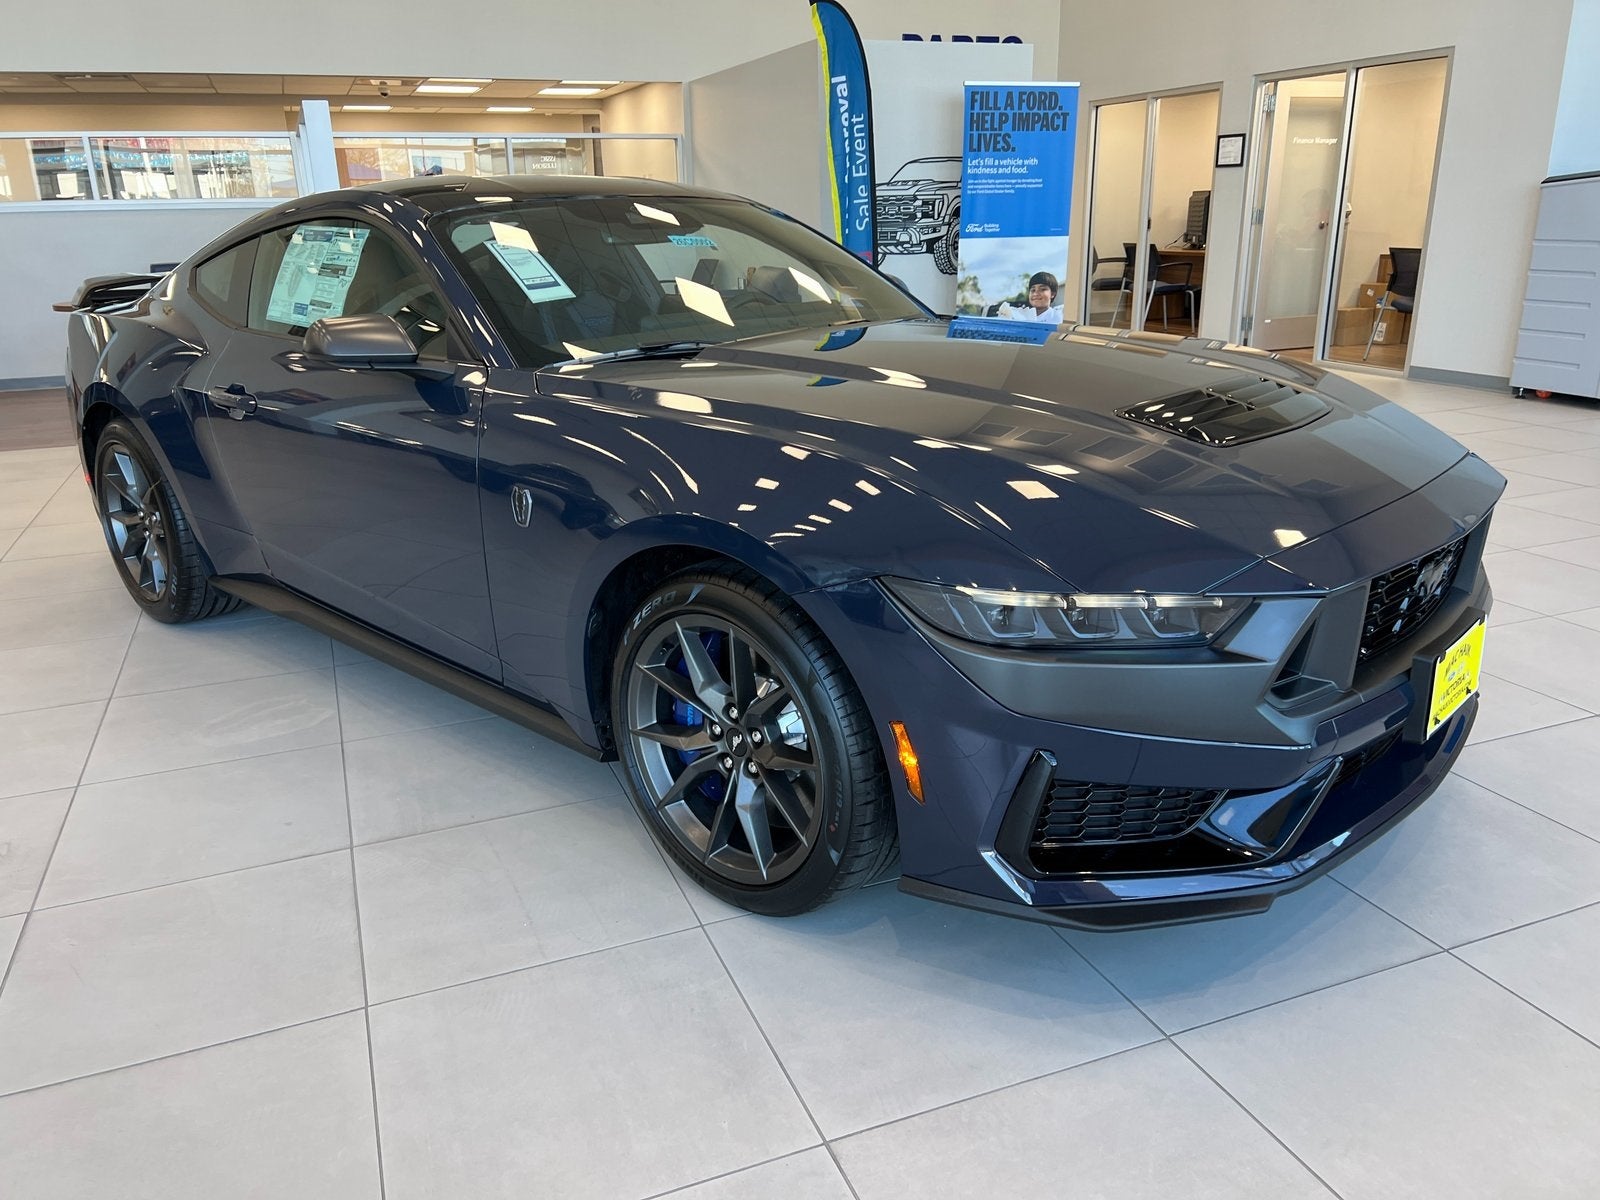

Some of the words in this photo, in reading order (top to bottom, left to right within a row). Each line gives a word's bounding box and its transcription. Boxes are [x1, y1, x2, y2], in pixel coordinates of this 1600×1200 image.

[970, 91, 1001, 111] FILL
[1004, 91, 1015, 111] A
[1017, 91, 1063, 111] FORD.
[969, 112, 1009, 132] HELP
[1012, 112, 1070, 132] IMPACT
[850, 113, 868, 178] Event
[968, 133, 1016, 152] LIVES.
[1315, 137, 1338, 146] Manager
[968, 158, 984, 166] Let's
[1024, 157, 1038, 165] with
[998, 166, 1011, 174] and
[1012, 166, 1029, 174] food.
[853, 187, 869, 230] Sale
[966, 224, 984, 233] Ford
[632, 590, 678, 631] ZERO
